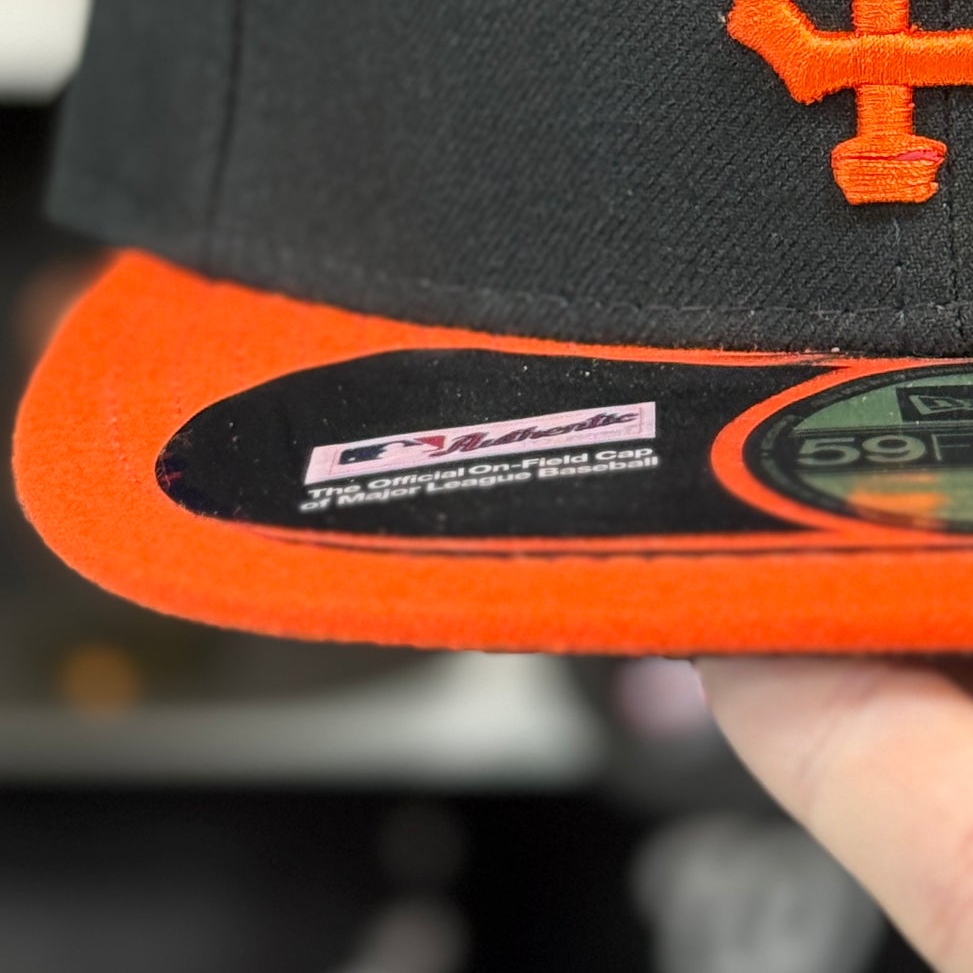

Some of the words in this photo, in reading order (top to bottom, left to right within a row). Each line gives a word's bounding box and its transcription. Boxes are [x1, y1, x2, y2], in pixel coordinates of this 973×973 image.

[428, 412, 640, 457] Authentic
[299, 497, 332, 512] of
[337, 485, 422, 505] Major
[426, 471, 533, 491] League
[537, 455, 659, 479] Baseball
[307, 484, 361, 500] The
[367, 467, 465, 490] Official
[468, 453, 588, 475] On-Field
[594, 447, 654, 464] Cap
